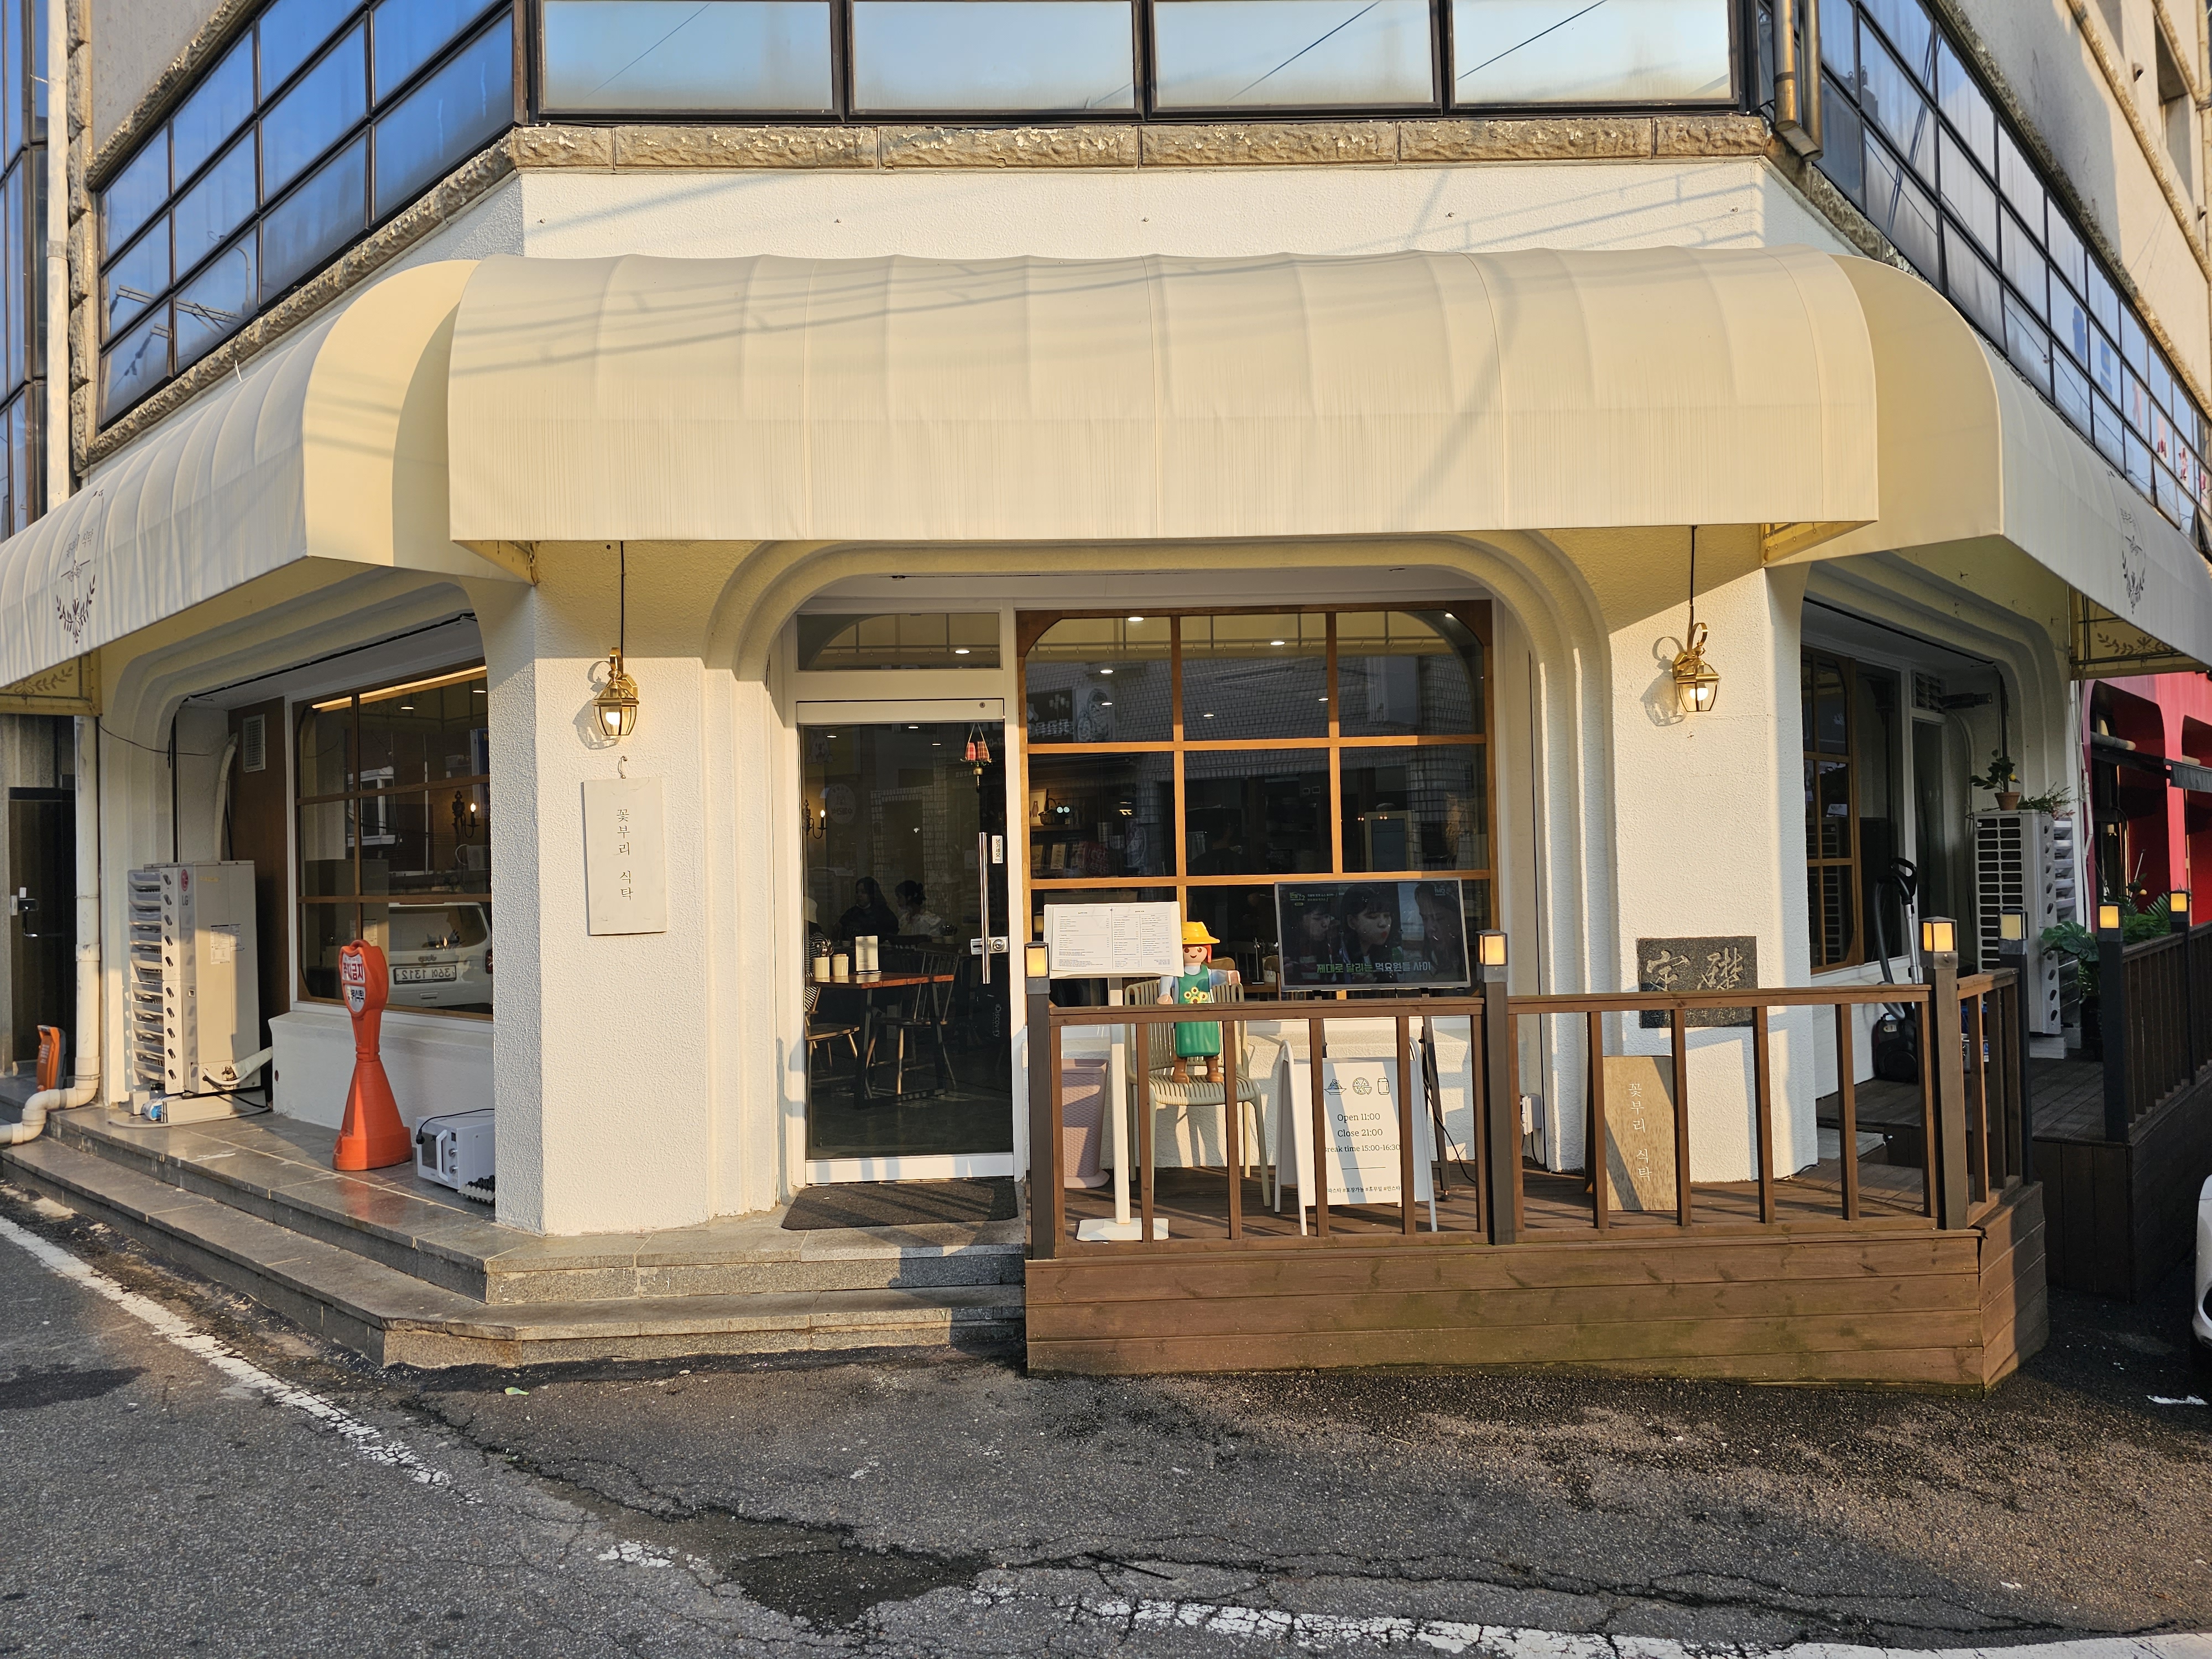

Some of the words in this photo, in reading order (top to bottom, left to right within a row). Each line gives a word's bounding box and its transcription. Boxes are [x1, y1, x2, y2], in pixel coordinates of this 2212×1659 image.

[616, 808, 631, 856] 꽃부리
[181, 895, 189, 906] LG
[619, 870, 634, 901] 식탁
[1317, 963, 1344, 973] 제대로
[1346, 963, 1373, 973] 달리는
[1375, 962, 1411, 972] 먹요원들
[1413, 961, 1431, 971] 사이
[1337, 1114, 1359, 1123] Open
[1628, 1083, 1646, 1133] 꽃부리
[1636, 1148, 1653, 1182] 식탁
